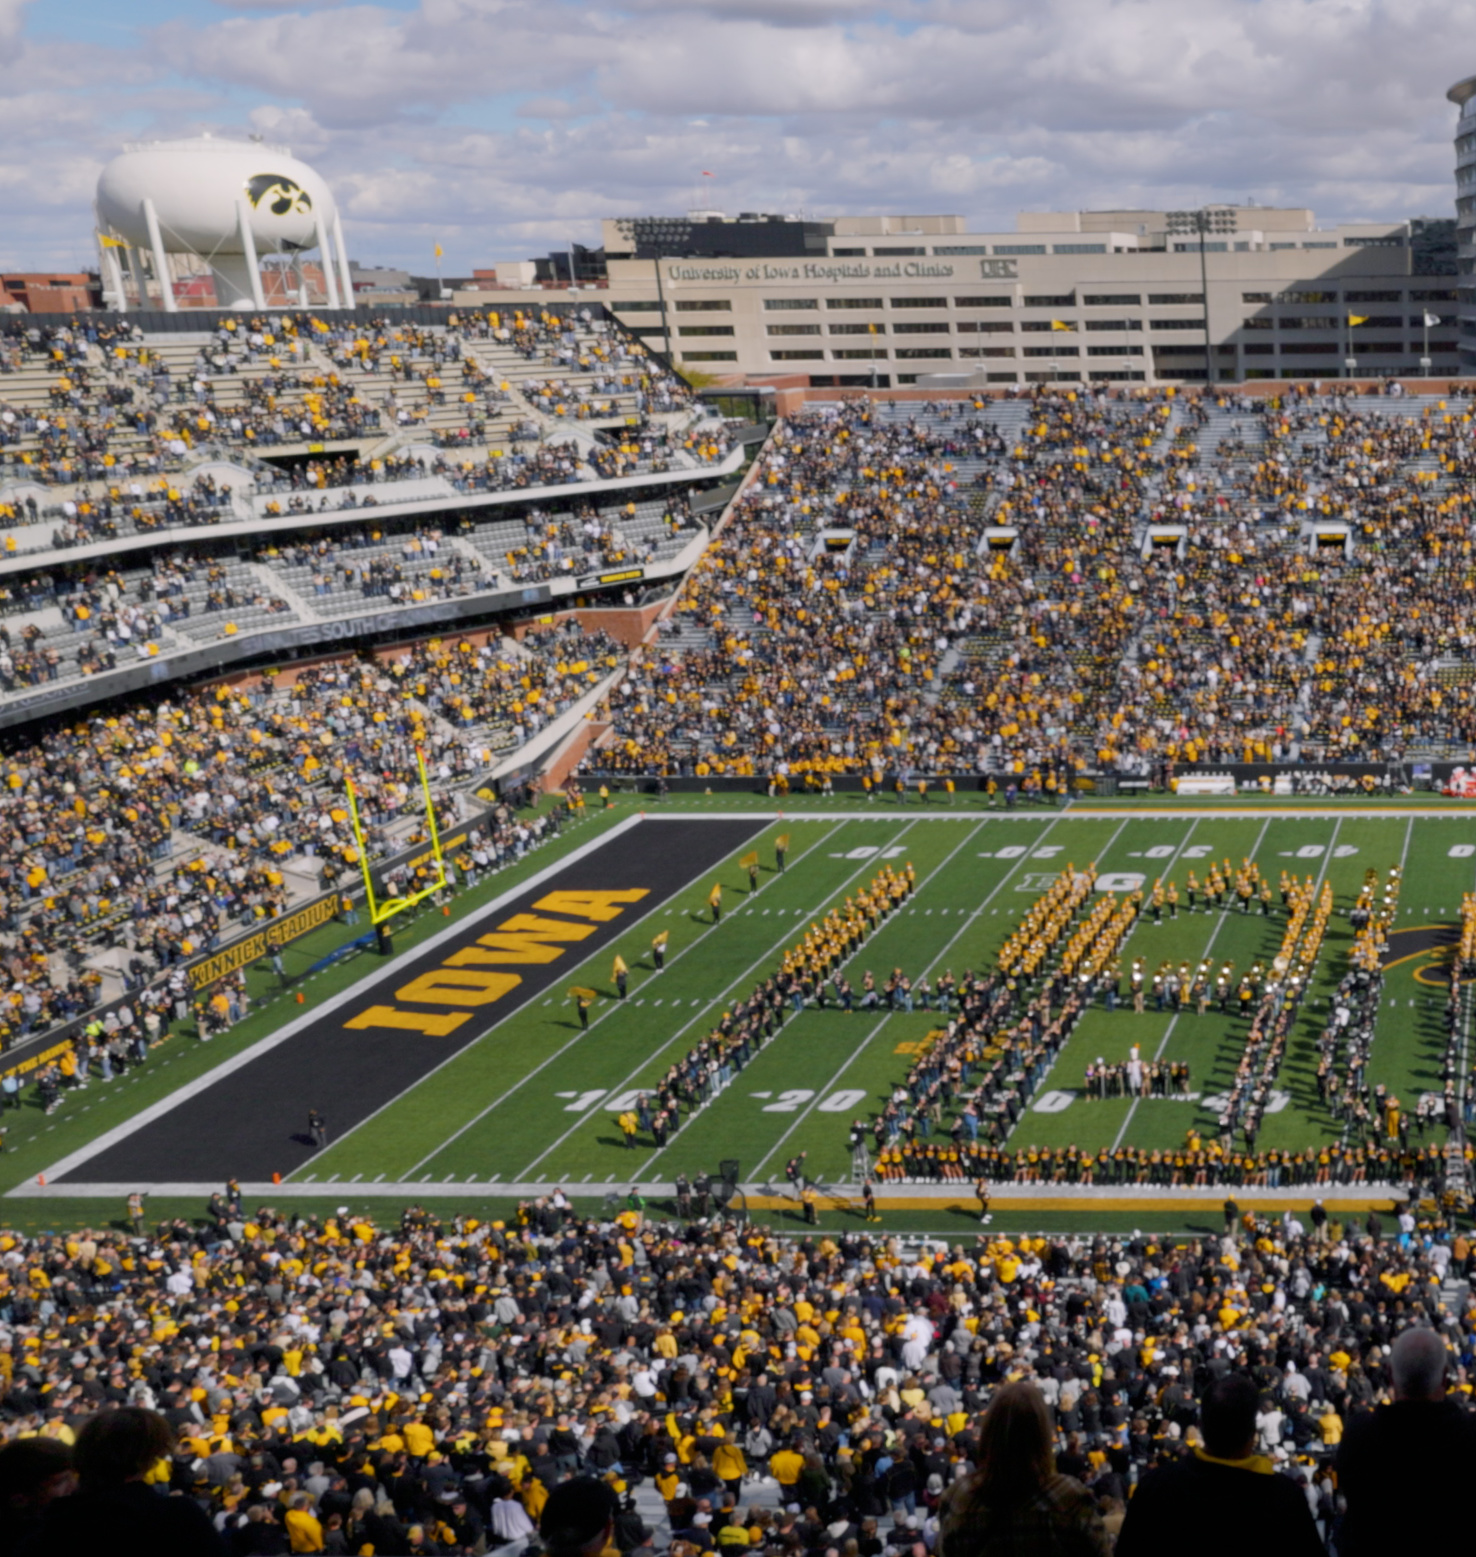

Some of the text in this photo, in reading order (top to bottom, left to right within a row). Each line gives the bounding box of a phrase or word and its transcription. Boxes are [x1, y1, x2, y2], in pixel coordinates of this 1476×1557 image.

[667, 261, 955, 284] University of Iowa Hospitals and Clinics
[321, 619, 375, 641] SOUTH
[378, 614, 399, 631] OF
[189, 894, 339, 990] KINNICK STADIUM
[342, 887, 652, 1038] IOWA
